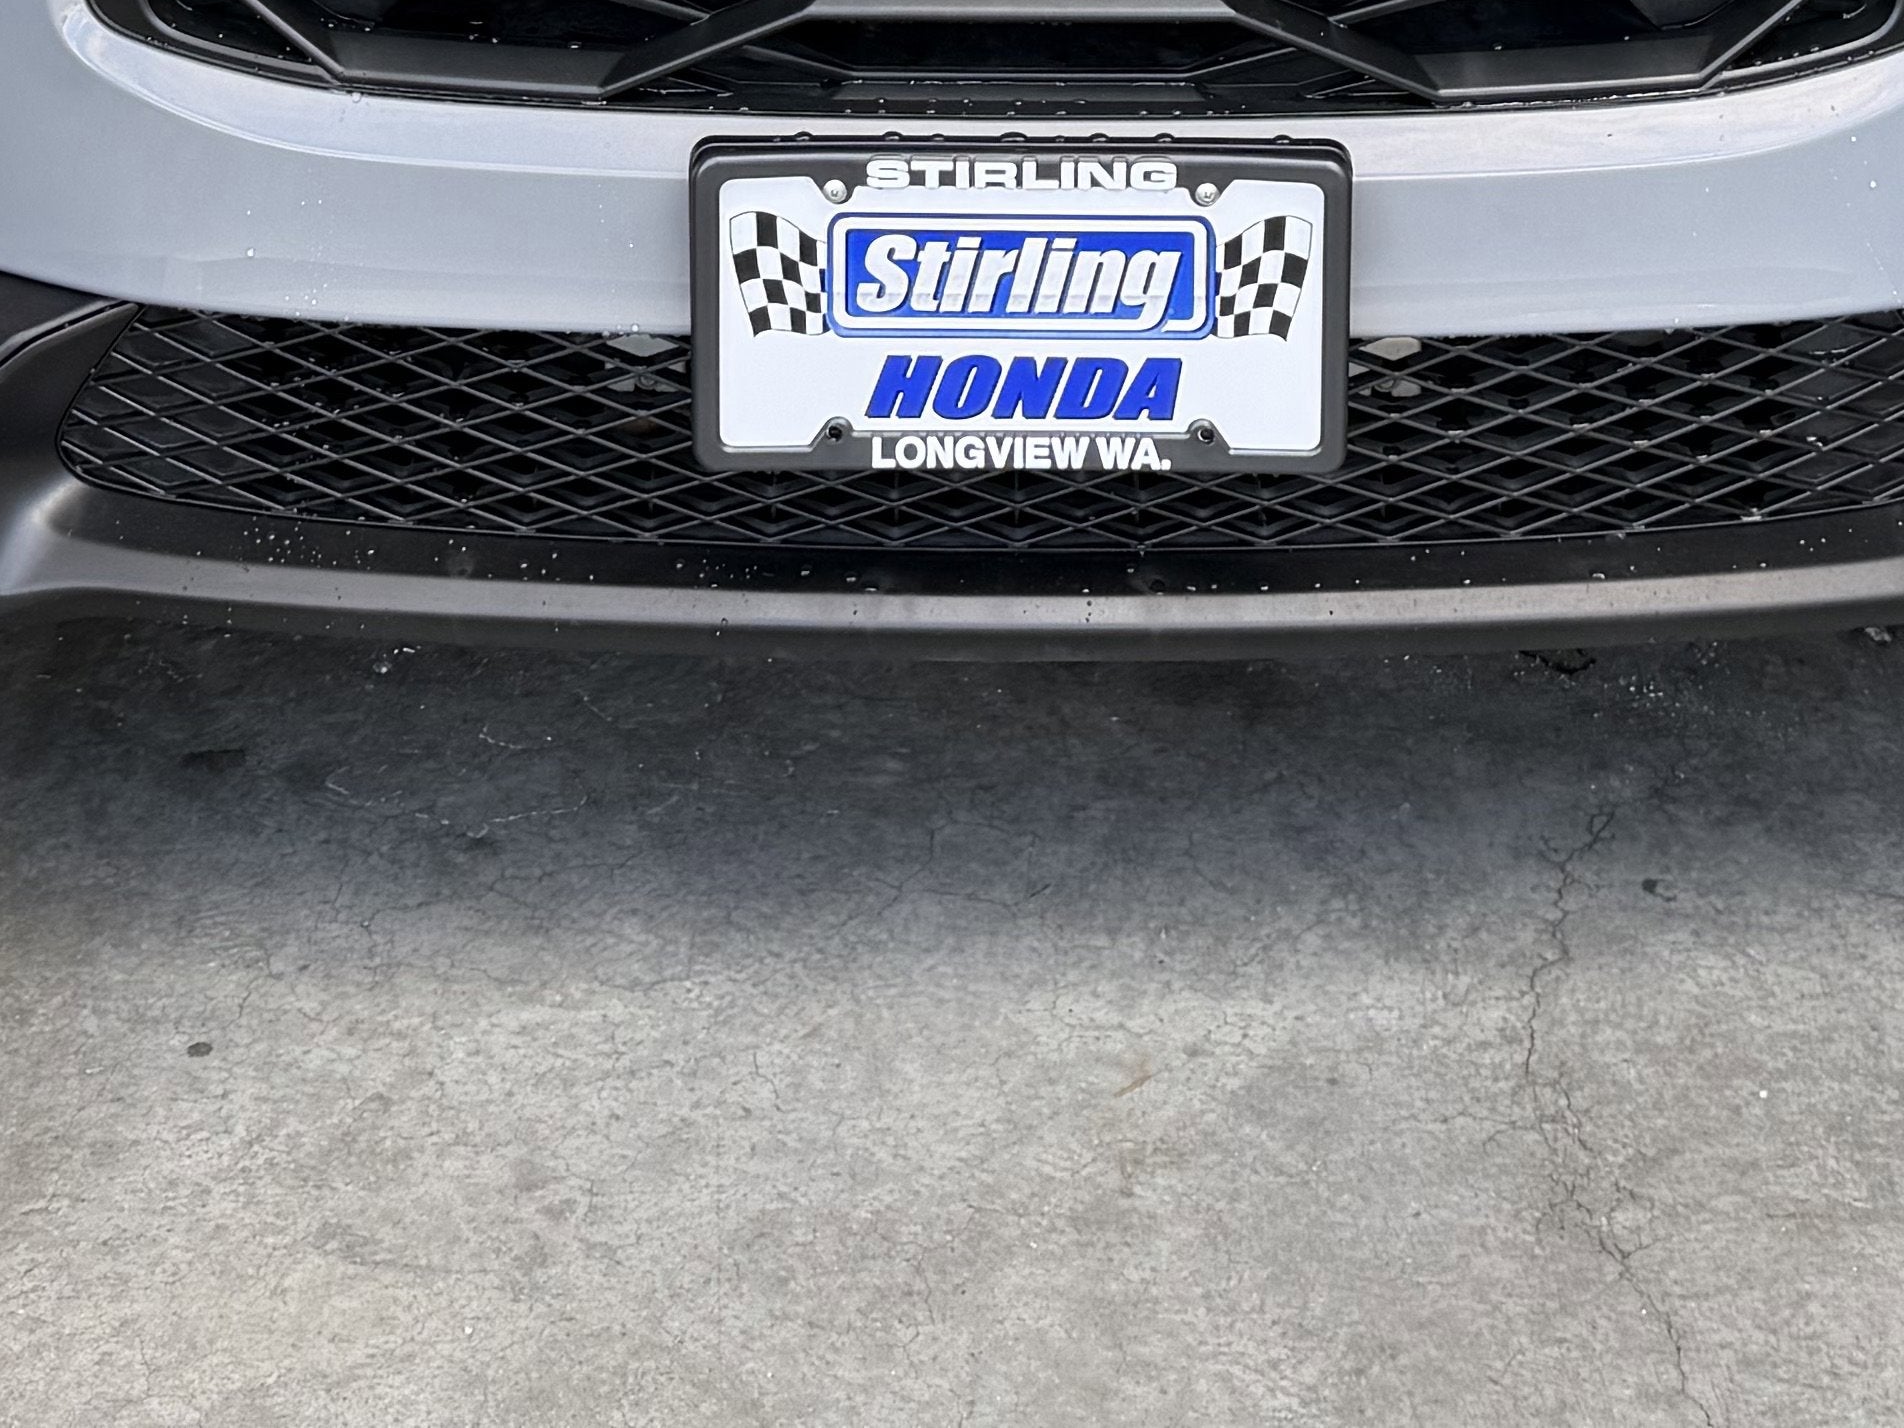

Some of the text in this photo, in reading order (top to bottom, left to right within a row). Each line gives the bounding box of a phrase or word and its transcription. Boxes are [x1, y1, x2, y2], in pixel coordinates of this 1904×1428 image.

[865, 155, 1179, 191] STIRLING
[856, 234, 1183, 332] Stirling
[864, 355, 1183, 420] HONDA
[871, 436, 1172, 470] LONGVIEW WA.
